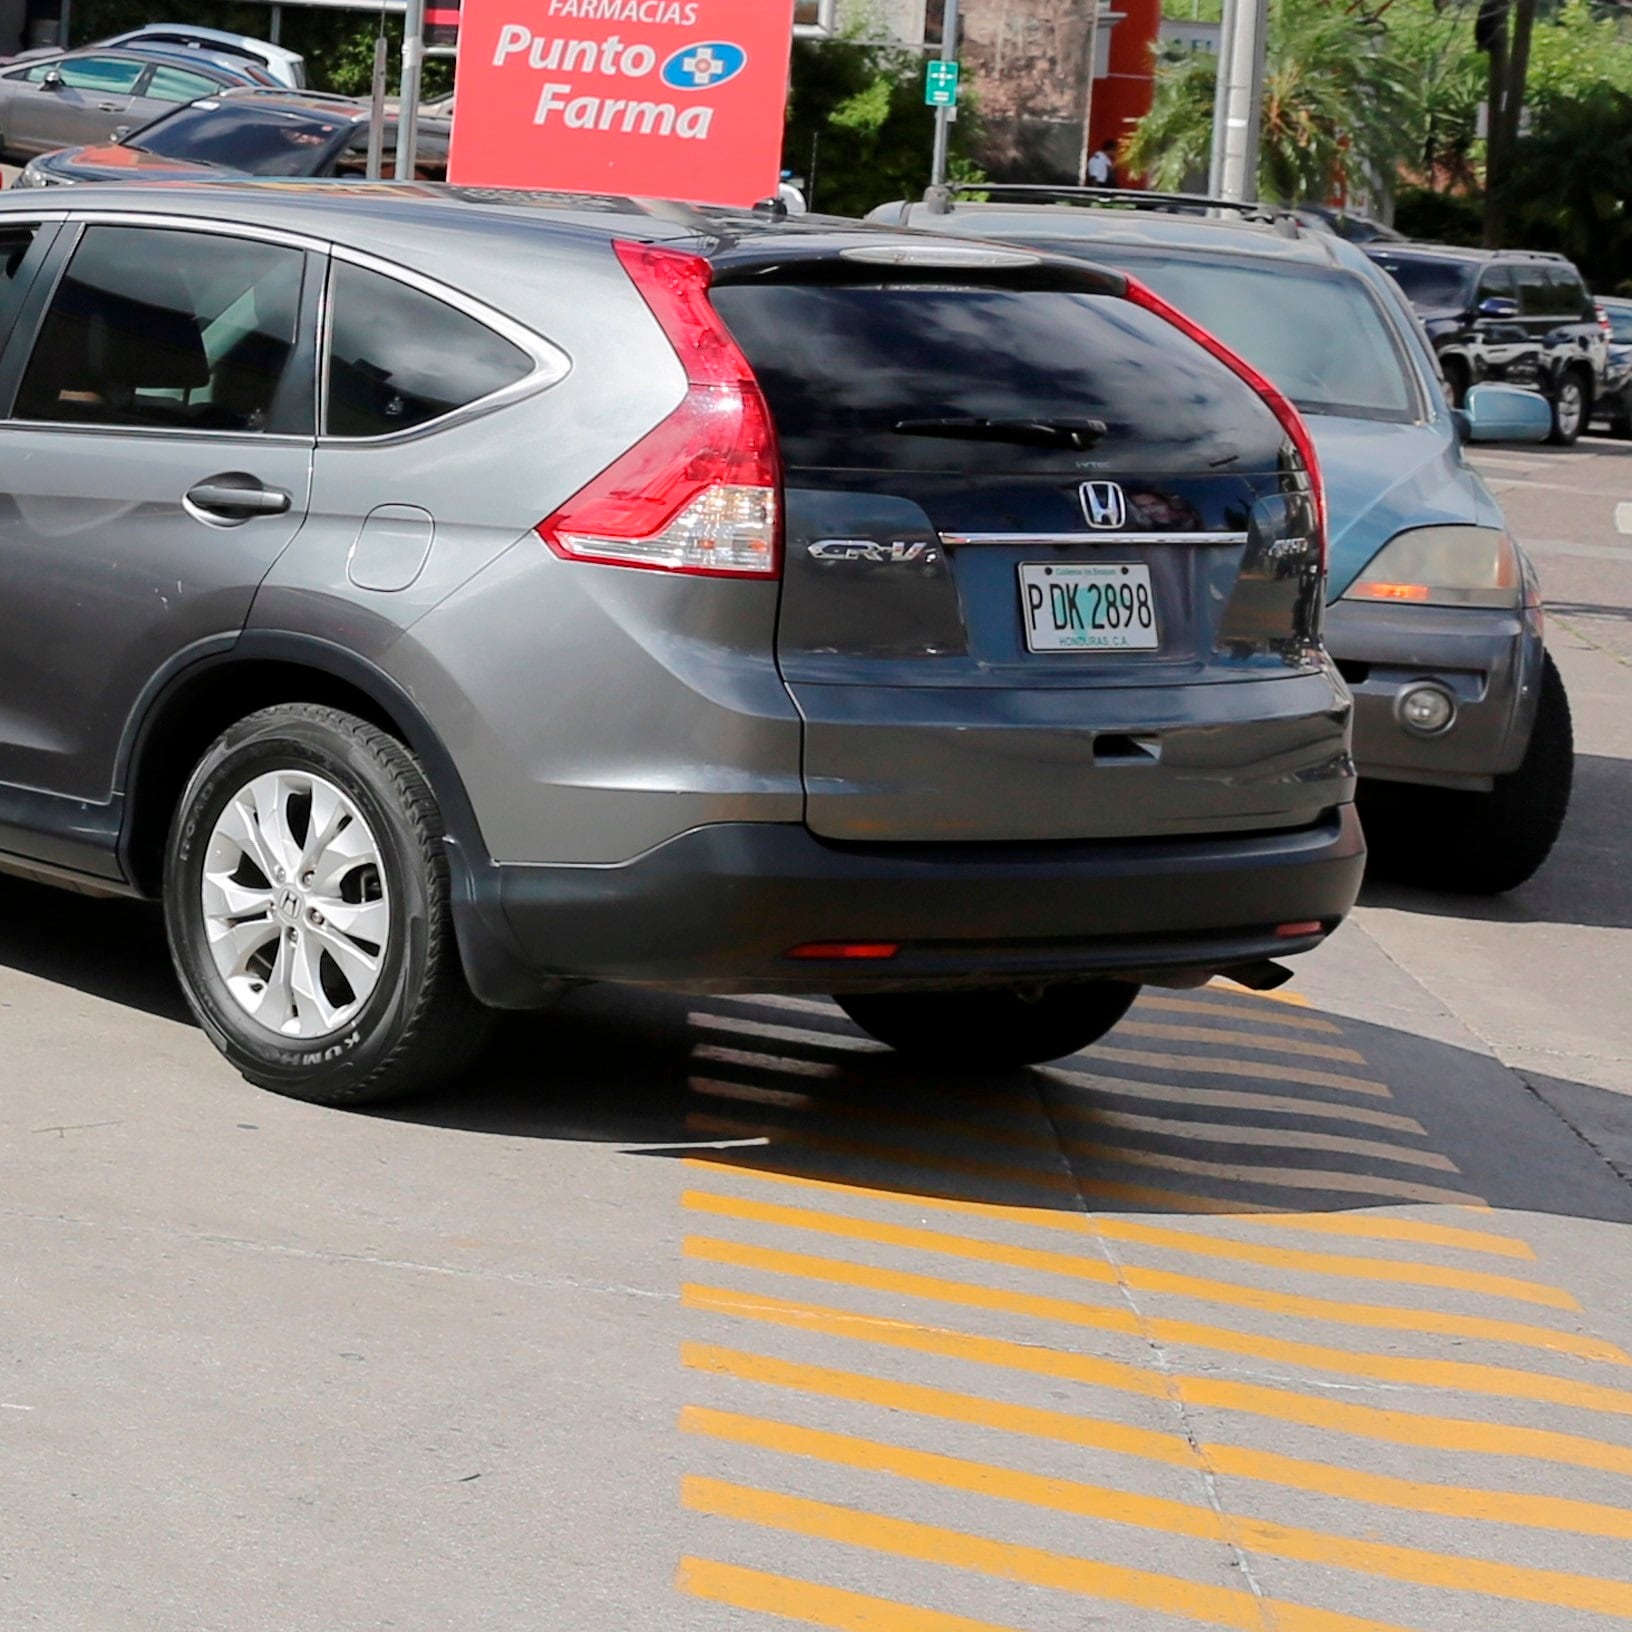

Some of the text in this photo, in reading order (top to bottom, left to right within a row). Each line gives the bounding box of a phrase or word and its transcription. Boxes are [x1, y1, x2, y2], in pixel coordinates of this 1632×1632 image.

[492, 23, 657, 78] Punto
[532, 82, 714, 140] Farma
[806, 539, 927, 562] CR-V
[1028, 583, 1043, 630] P
[1087, 583, 1152, 630] 2898
